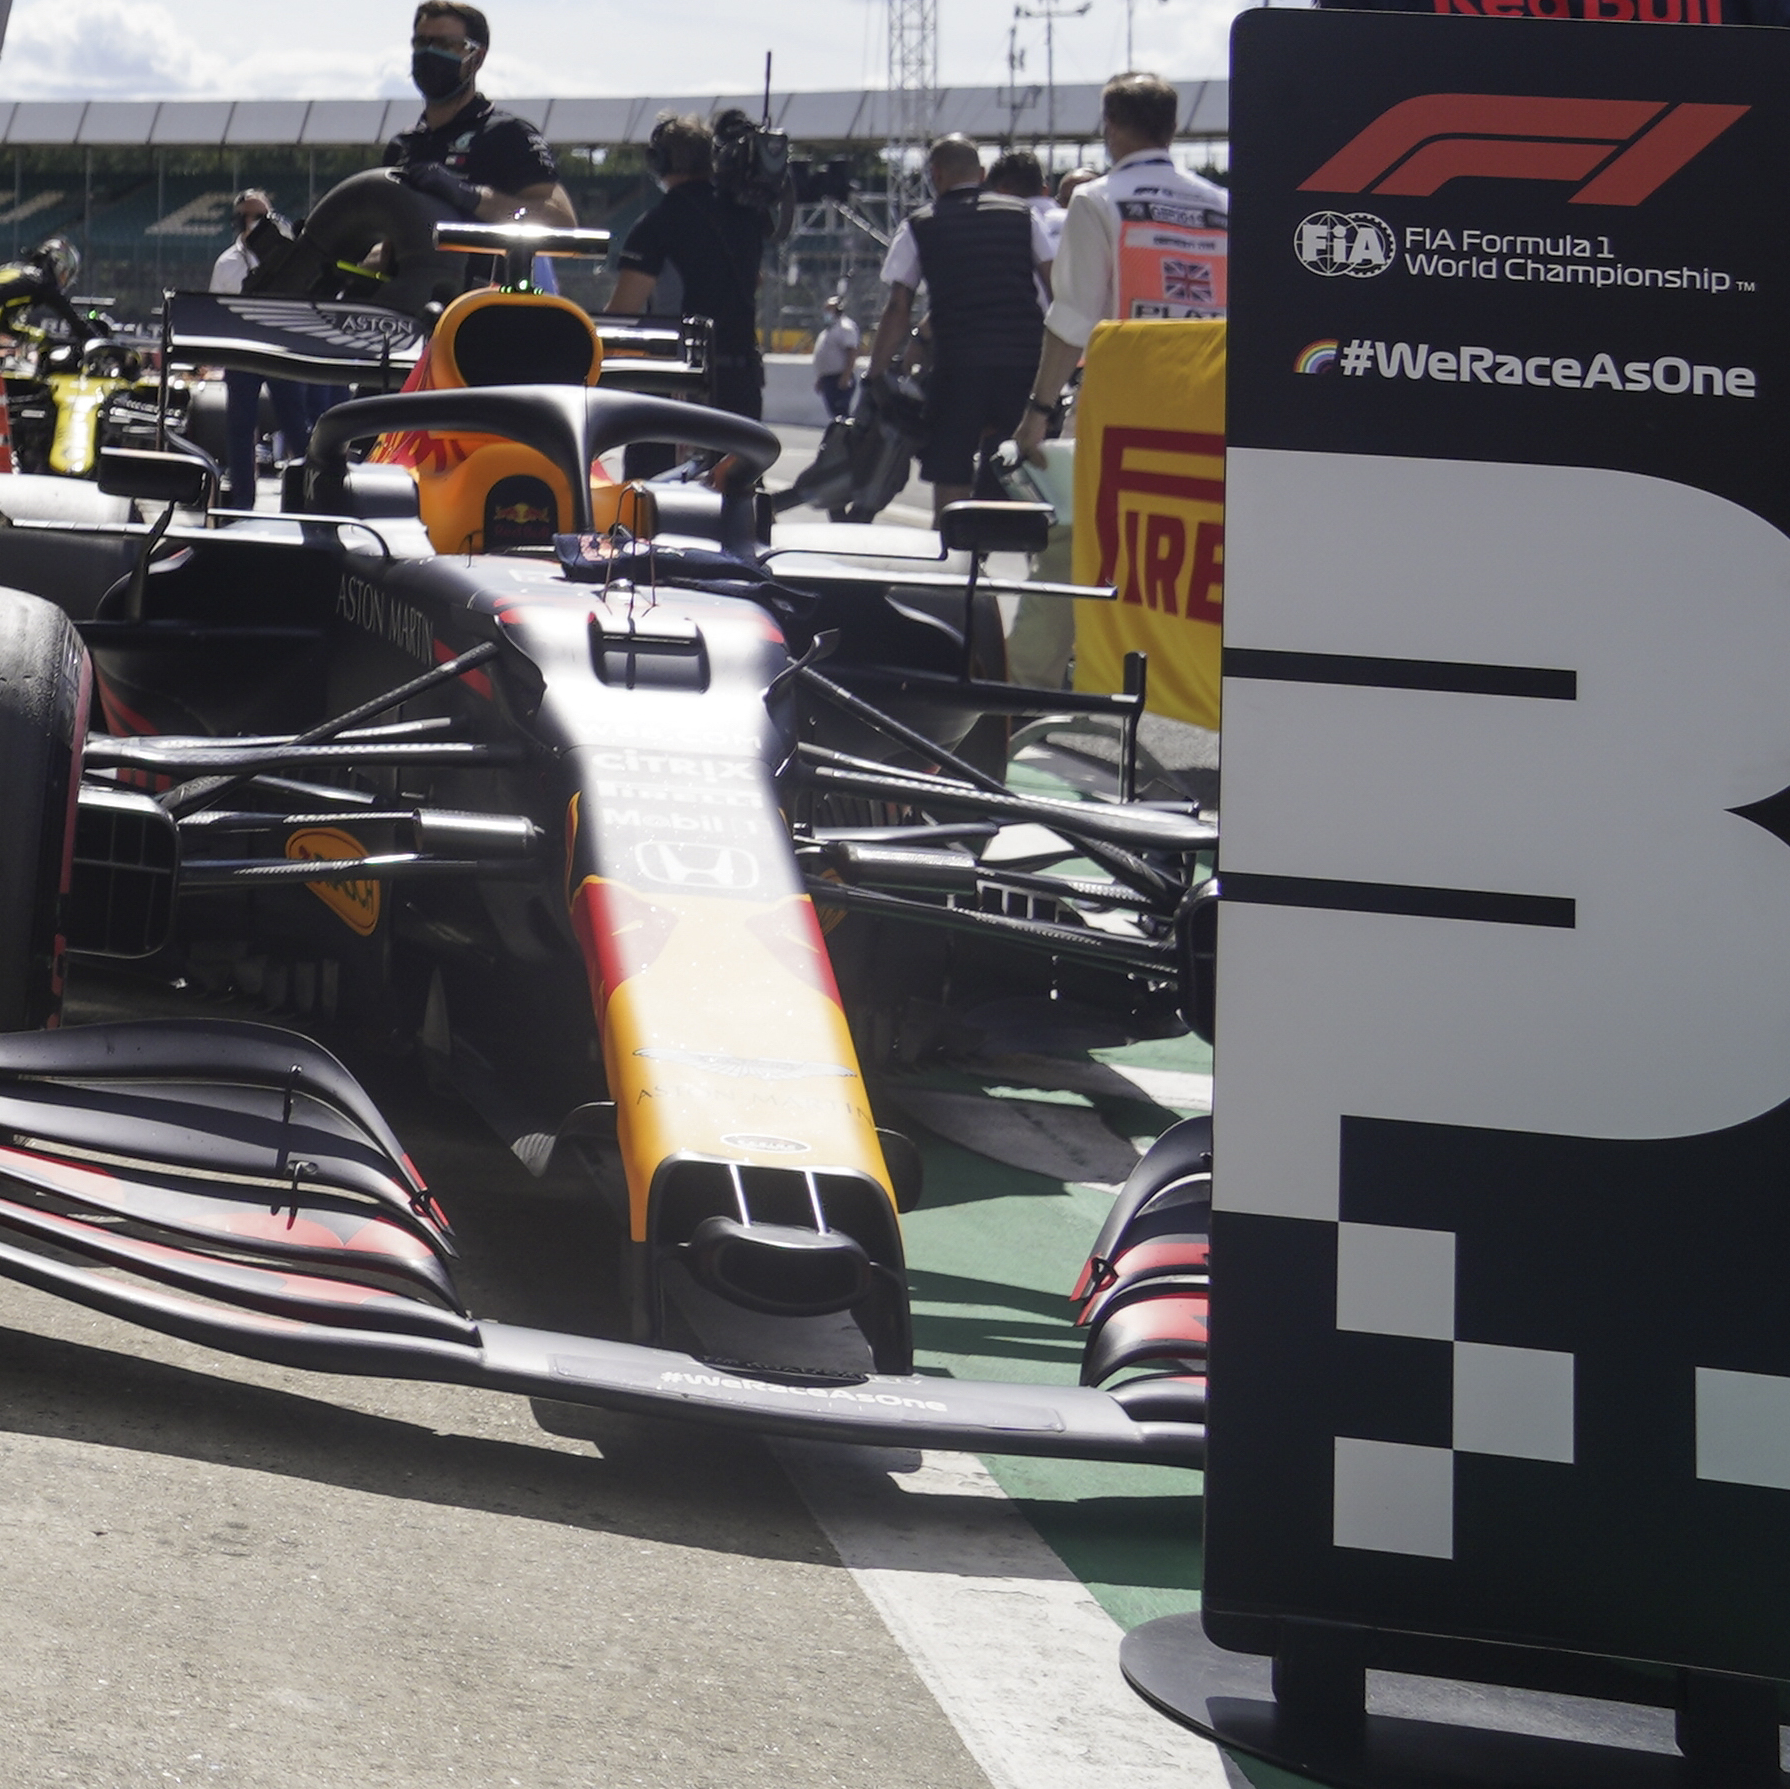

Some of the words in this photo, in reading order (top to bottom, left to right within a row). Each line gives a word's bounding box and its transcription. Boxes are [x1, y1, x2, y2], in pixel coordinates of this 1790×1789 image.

[1296, 93, 1752, 206] F1
[1405, 227, 1456, 253] FIA
[1462, 229, 1591, 259] Formula
[1597, 236, 1614, 259] 1
[1404, 252, 1496, 280] World
[1503, 257, 1730, 293] Championship
[341, 315, 414, 336] ASTON
[1340, 339, 1756, 398] #WeRaceAsOne
[336, 573, 384, 637] ASTON
[388, 596, 434, 667] MARTIN
[660, 1371, 949, 1413] #WeRaceAsOne
